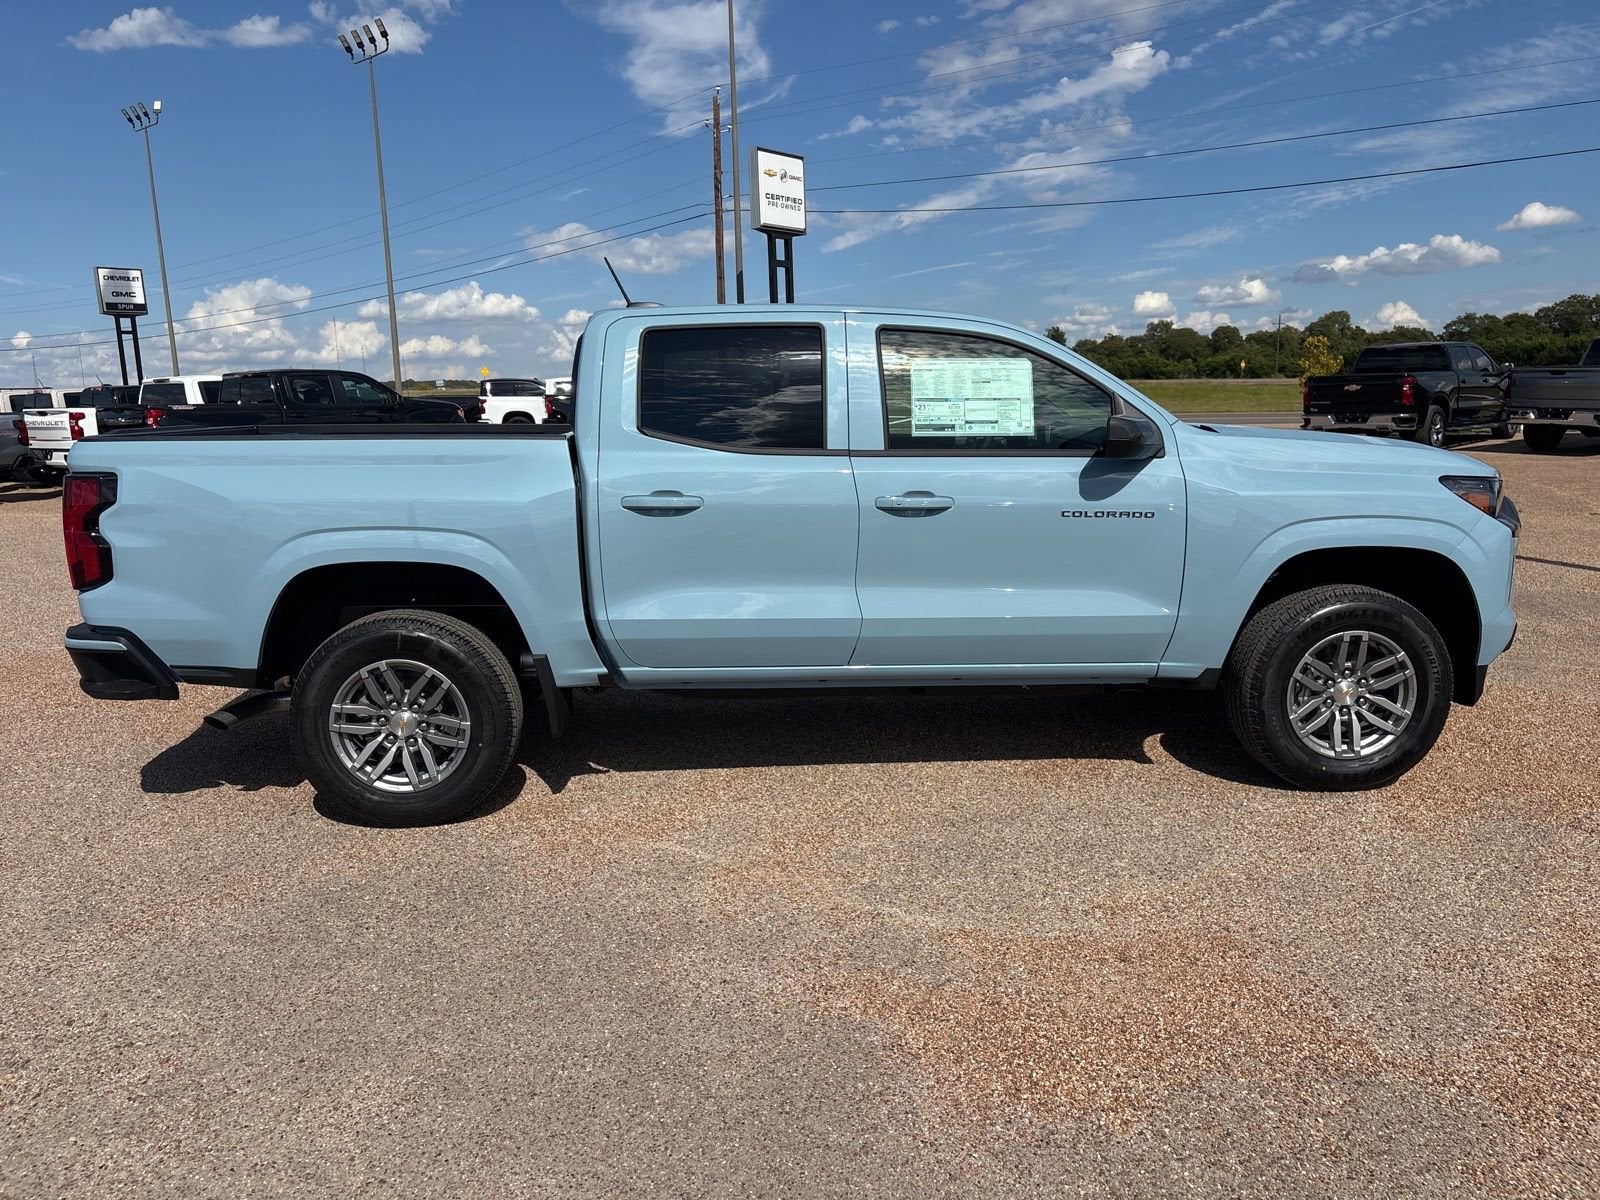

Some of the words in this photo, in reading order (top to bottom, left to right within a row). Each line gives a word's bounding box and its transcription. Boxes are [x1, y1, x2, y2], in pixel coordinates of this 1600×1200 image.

[788, 174, 803, 182] GMC
[765, 192, 803, 205] CERTIFIED
[767, 200, 802, 212] PRE-OWNED
[1296, 608, 1393, 643] WRANGLER
